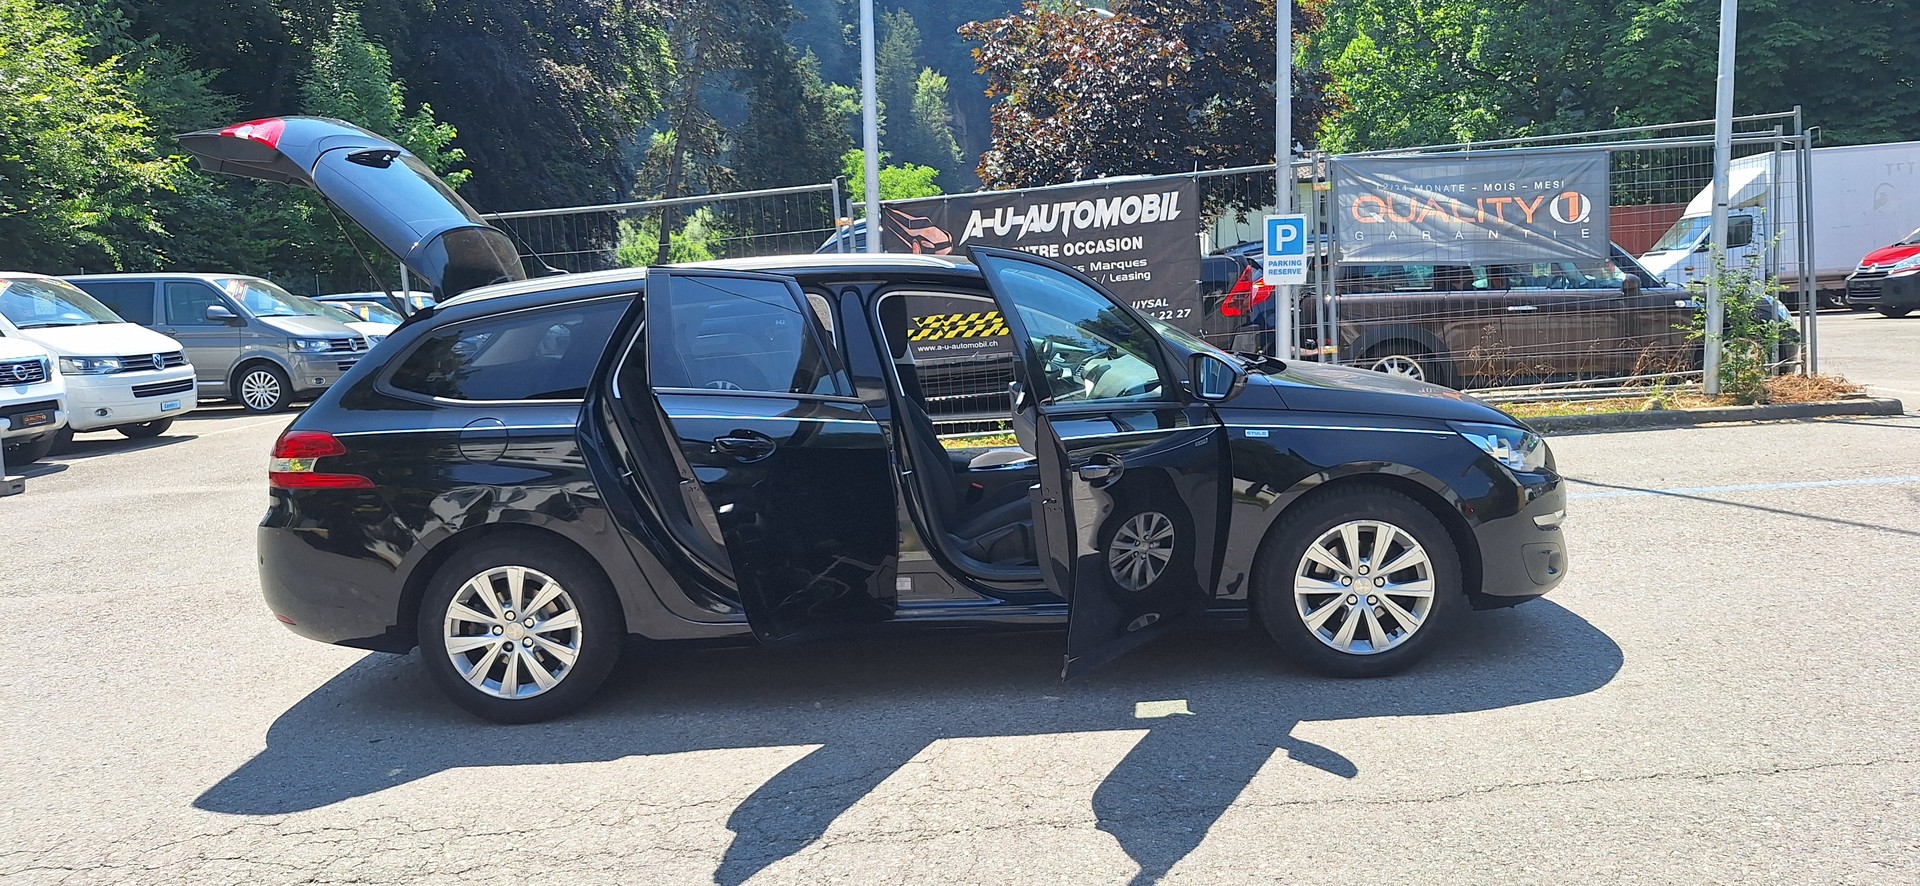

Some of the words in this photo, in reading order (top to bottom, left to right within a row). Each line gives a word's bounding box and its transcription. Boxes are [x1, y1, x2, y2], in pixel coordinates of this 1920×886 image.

[1414, 183, 1465, 192] MONATE
[1484, 182, 1516, 192] MOIS
[1534, 180, 1565, 190] MESI
[1351, 194, 1545, 223] QUALITY
[959, 191, 1182, 246] A-U-AUTOMOBIL
[1275, 224, 1297, 252] P
[1354, 228, 1590, 241] GARANTIE
[1012, 244, 1060, 259] TRE
[1063, 236, 1143, 257] OCCASION
[1090, 258, 1148, 271] Marques
[1109, 271, 1151, 282] Leasing
[1176, 308, 1192, 318] 27
[917, 340, 999, 352] www.a-u-automobil.ch
